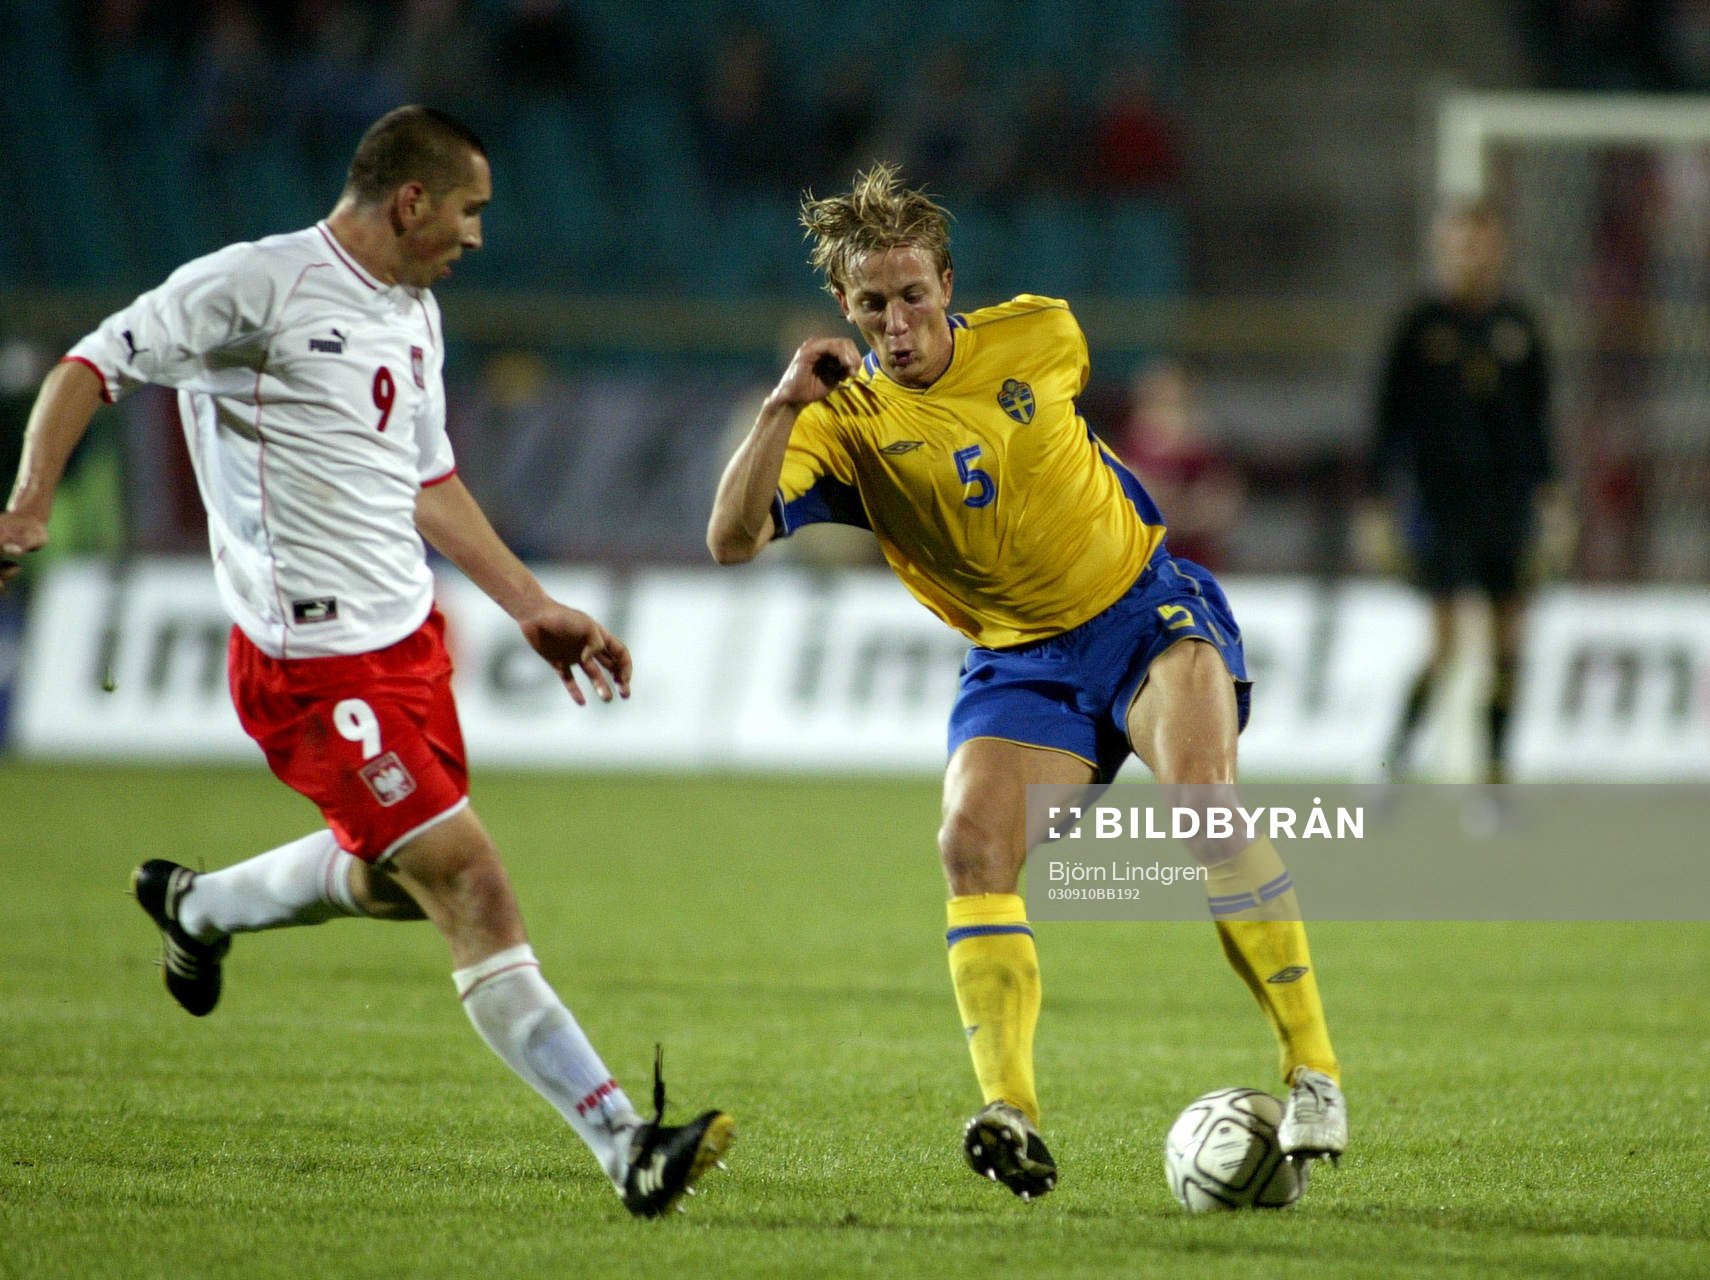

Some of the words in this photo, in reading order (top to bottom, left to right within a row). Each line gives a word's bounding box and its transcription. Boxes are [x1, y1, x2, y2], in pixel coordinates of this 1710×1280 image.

[372, 366, 396, 432] 9
[953, 444, 995, 508] 5
[1157, 604, 1195, 630] 5
[333, 698, 381, 760] 9
